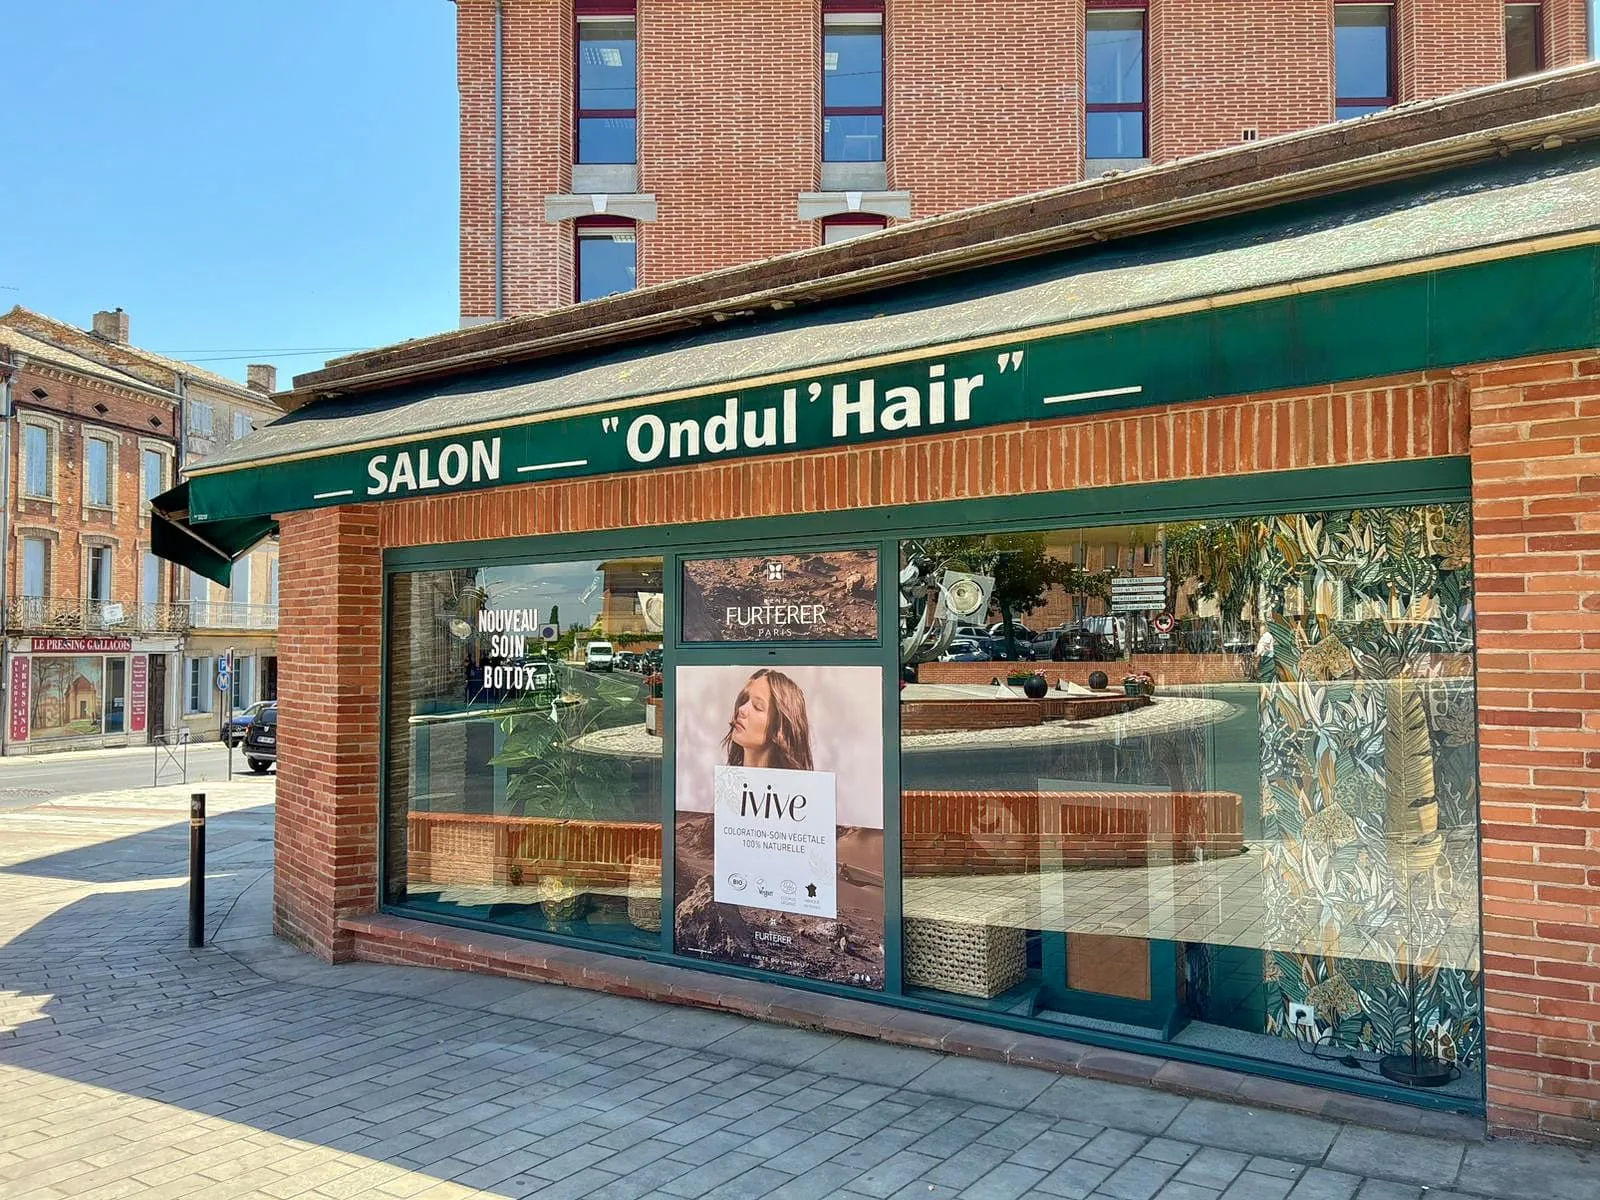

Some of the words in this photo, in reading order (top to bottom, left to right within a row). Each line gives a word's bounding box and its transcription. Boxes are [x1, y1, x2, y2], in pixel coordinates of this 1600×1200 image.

[367, 437, 501, 496] SALON
[478, 608, 538, 633] NOUVEAU
[726, 604, 826, 626] FURTERER
[758, 628, 792, 637] PARIS
[34, 639, 45, 650] LE
[491, 634, 525, 658] SOIN
[483, 665, 536, 690] BOTOX
[740, 783, 807, 822] ivive
[743, 839, 761, 849] 100%
[763, 841, 805, 854] NATURELLE
[754, 931, 792, 945] FURTERER
